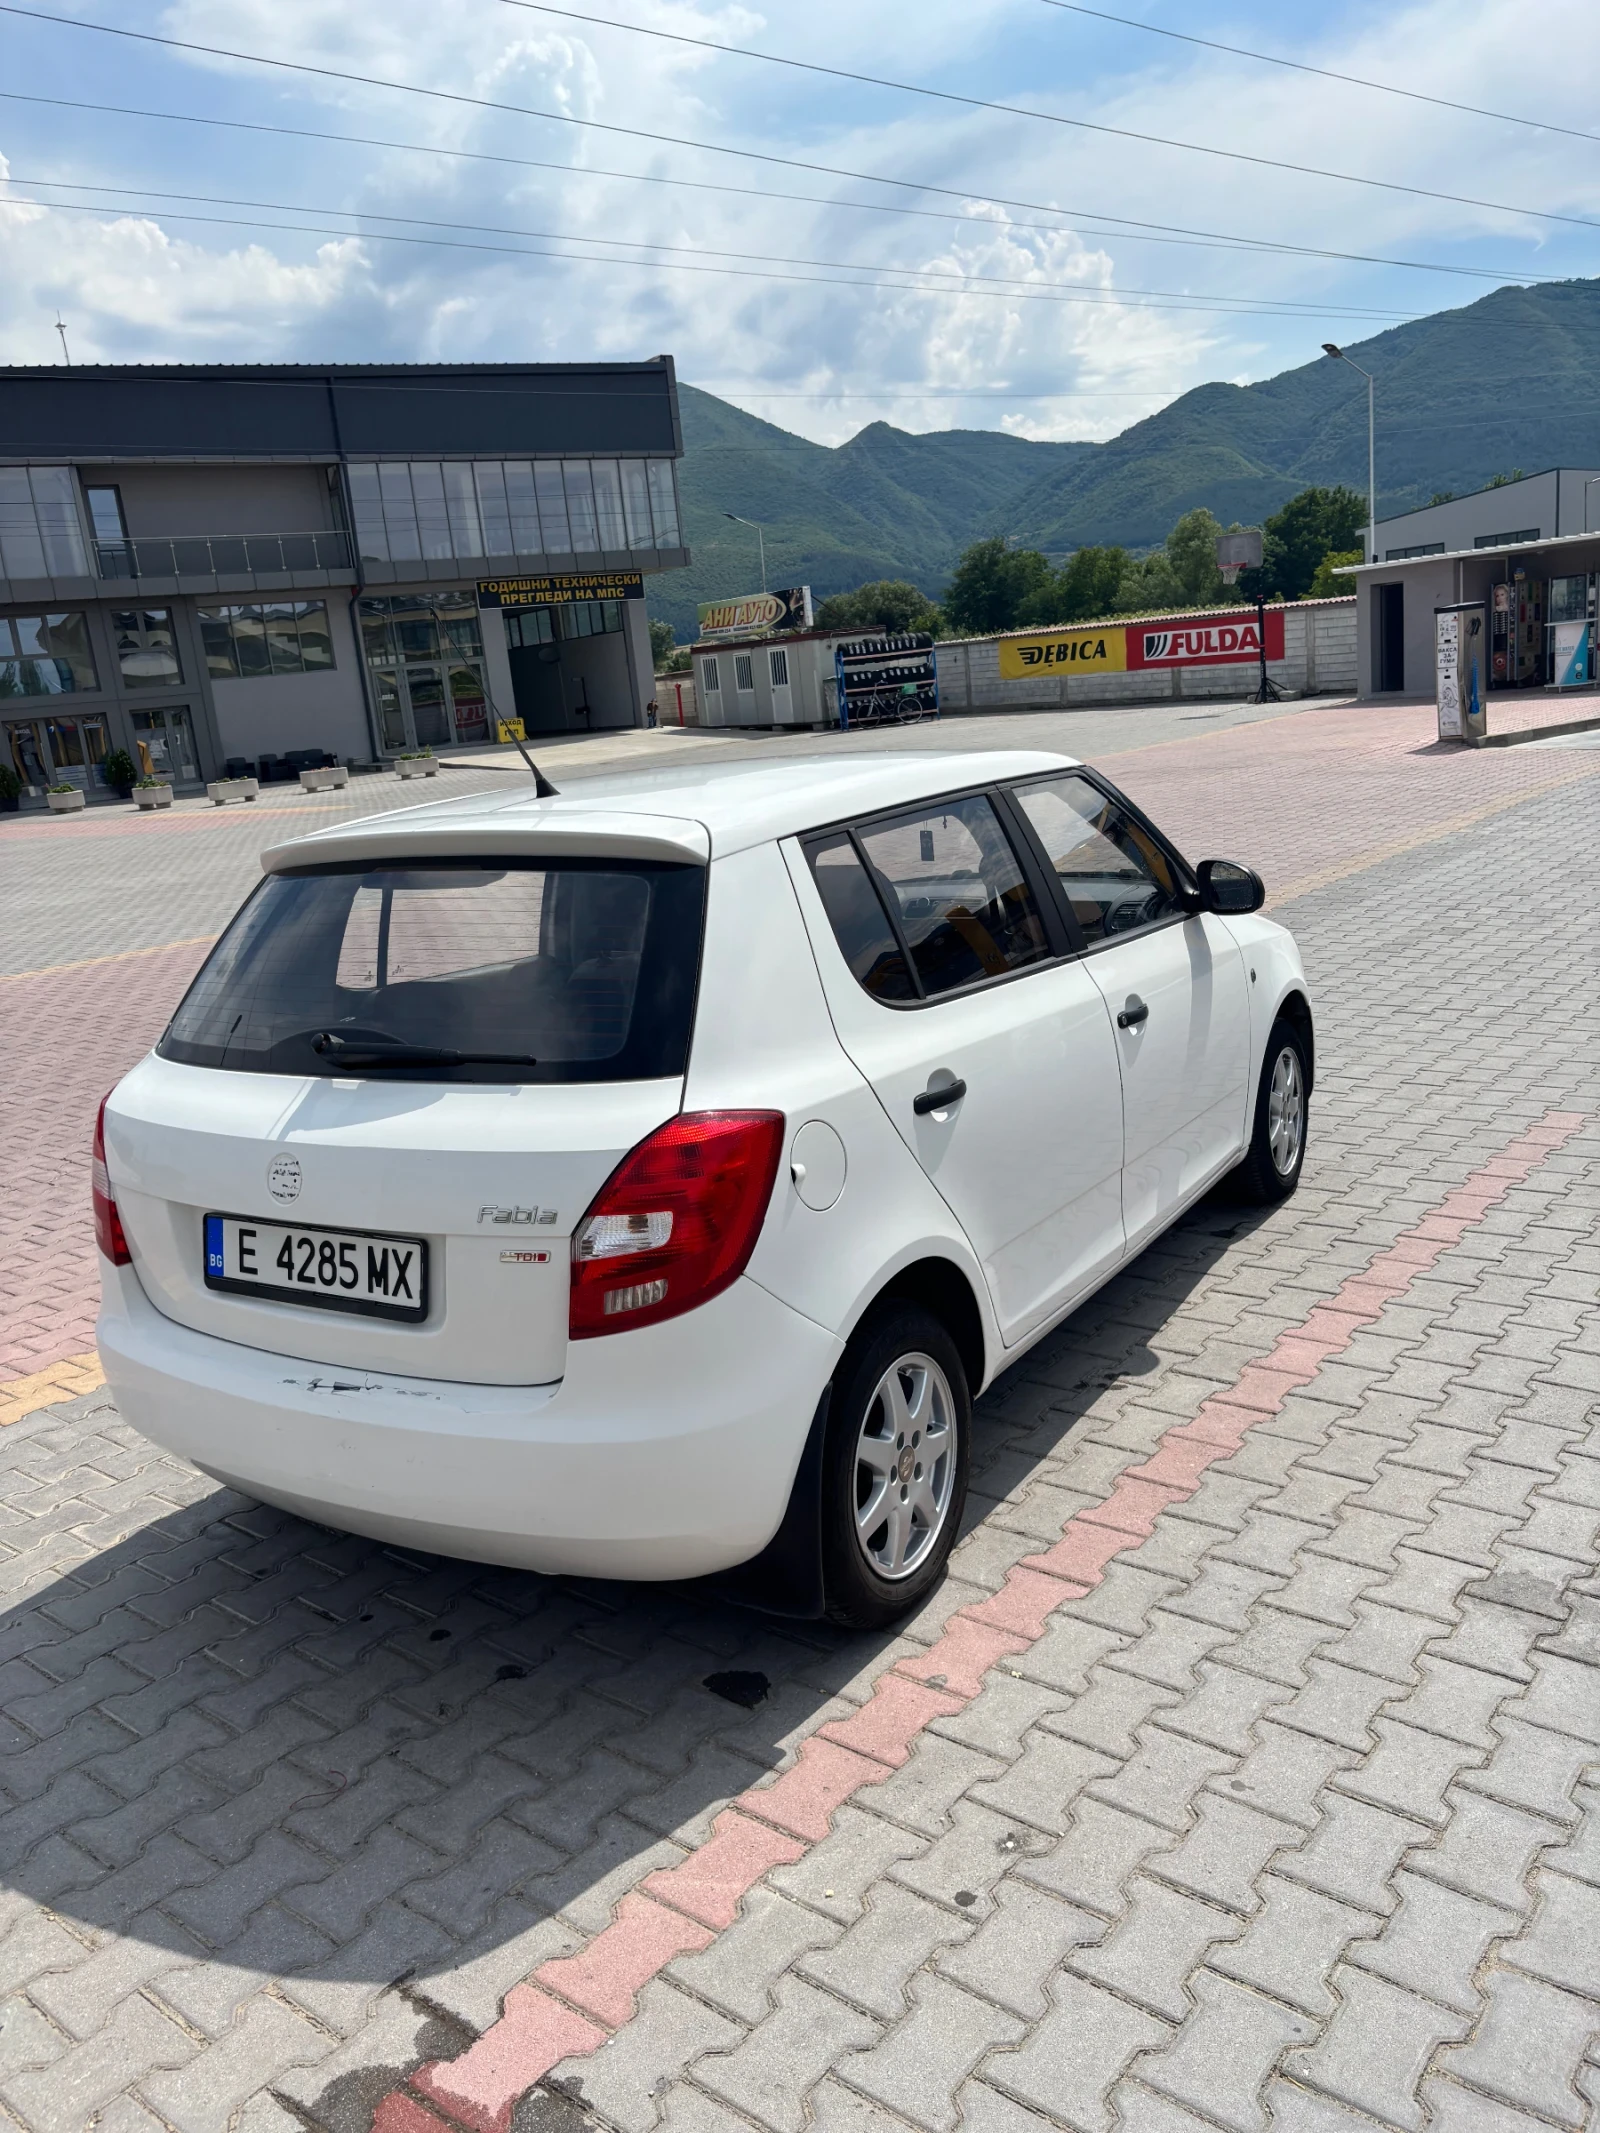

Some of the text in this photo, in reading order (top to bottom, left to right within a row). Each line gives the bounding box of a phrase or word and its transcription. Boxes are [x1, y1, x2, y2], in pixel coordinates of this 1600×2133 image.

[480, 574, 641, 593] ГОДИШНИ ТЕХНИЧЕСКИ
[501, 588, 625, 605] ПРЕГЛЕДИ НА МПС
[702, 598, 779, 630] АНИ АУТО
[1166, 625, 1260, 656] FULDA
[477, 1204, 558, 1224] Fabia
[210, 1254, 223, 1267] BG
[238, 1228, 413, 1299] E 4285 MX
[514, 1252, 536, 1261] TDI
